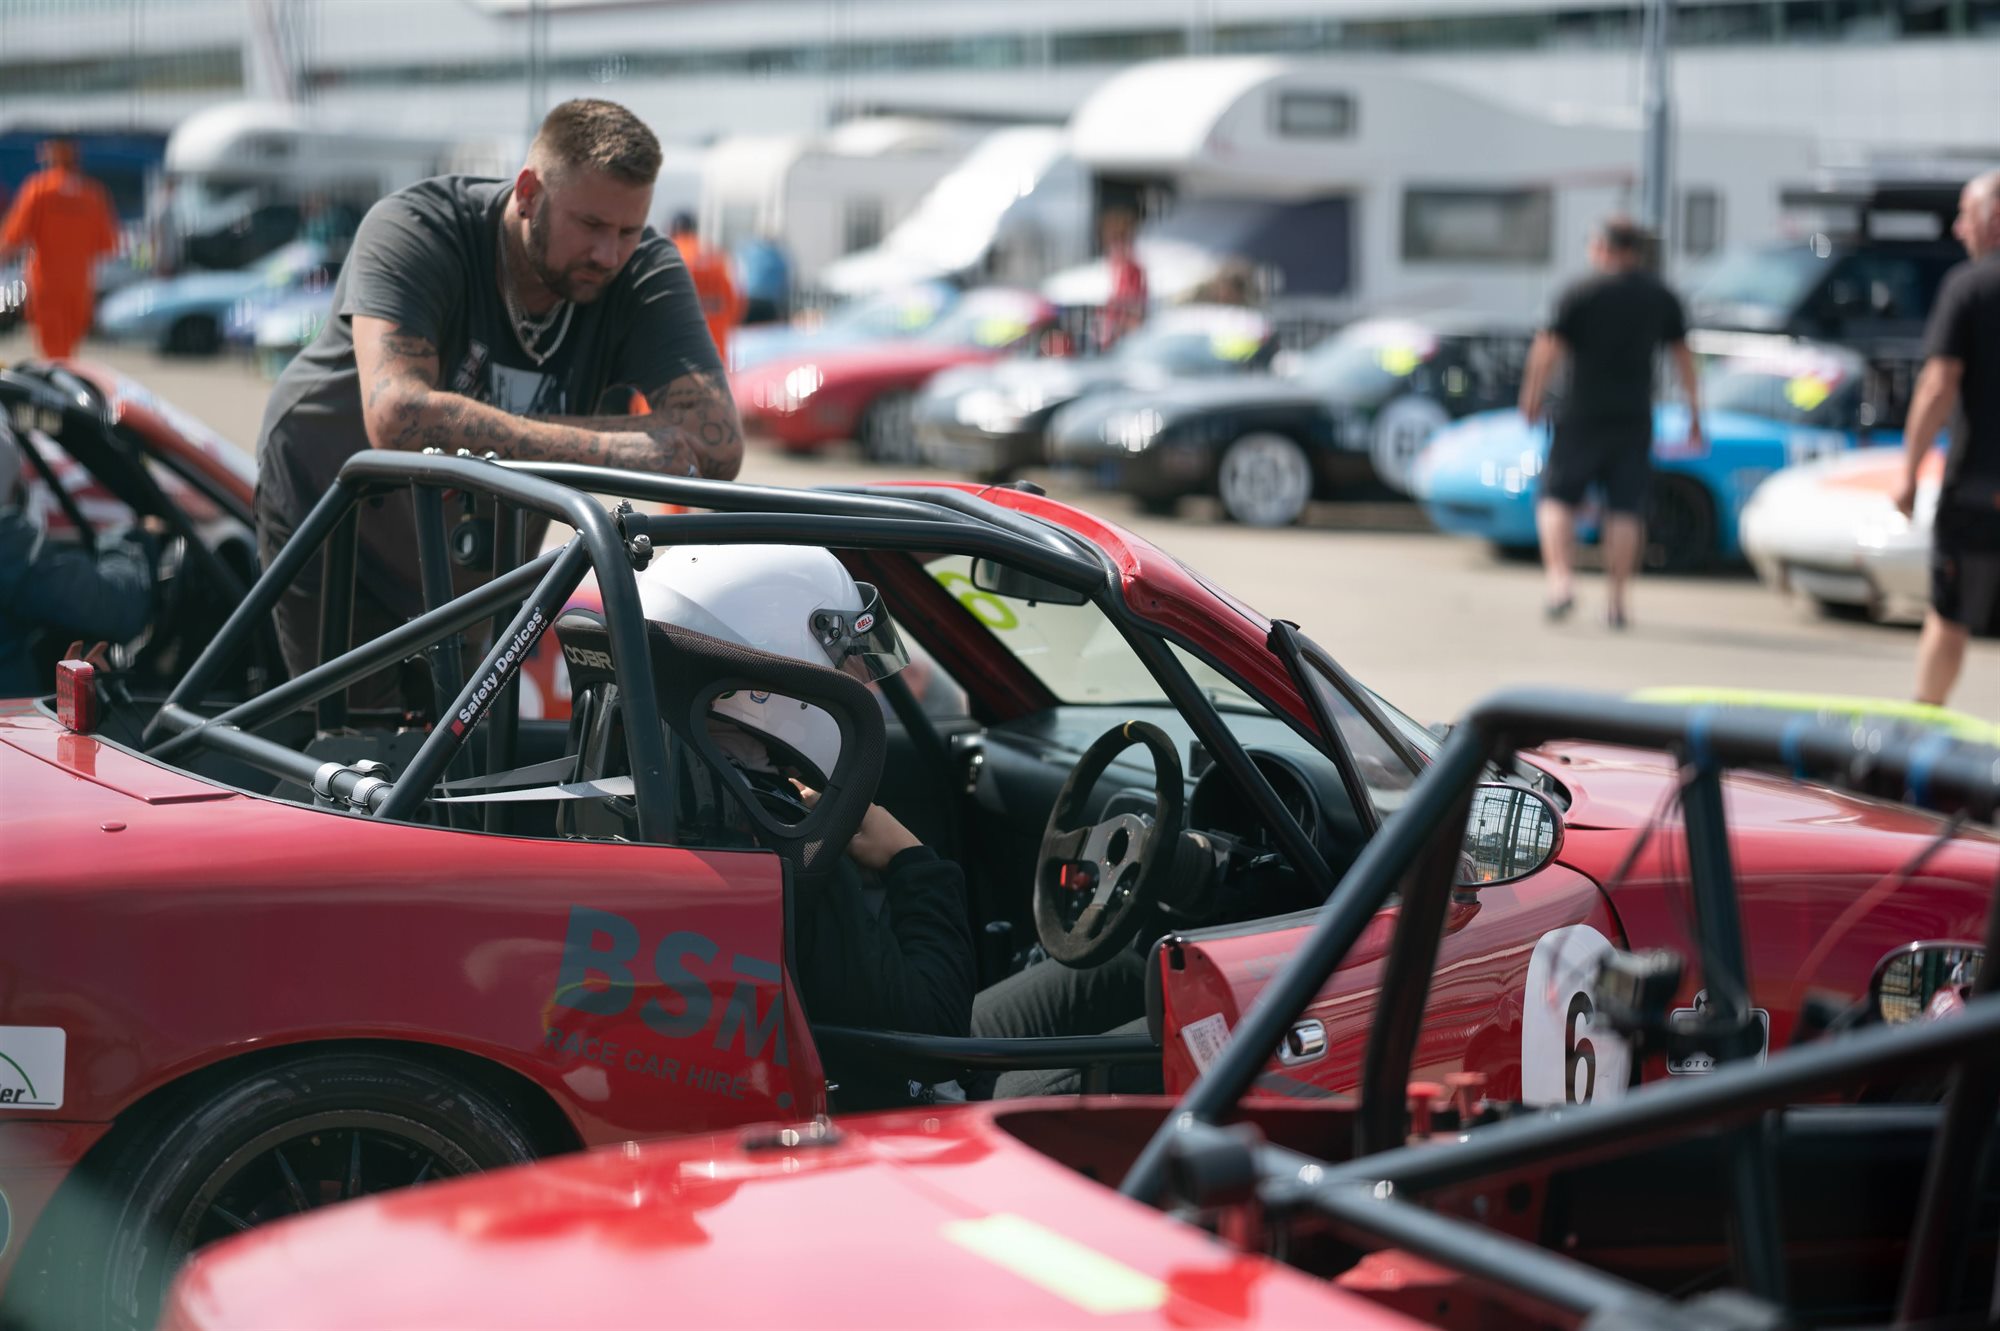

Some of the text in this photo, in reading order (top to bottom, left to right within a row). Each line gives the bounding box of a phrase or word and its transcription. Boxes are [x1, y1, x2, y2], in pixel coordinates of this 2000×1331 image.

[856, 616, 872, 629] BELL
[516, 631, 542, 663] International
[565, 644, 615, 670] COBR
[459, 672, 498, 723] Safety
[555, 904, 788, 1067] BSM
[545, 1027, 749, 1099] RACE CAR HIRE
[1565, 991, 1596, 1106] 6
[0, 1084, 26, 1102] er
